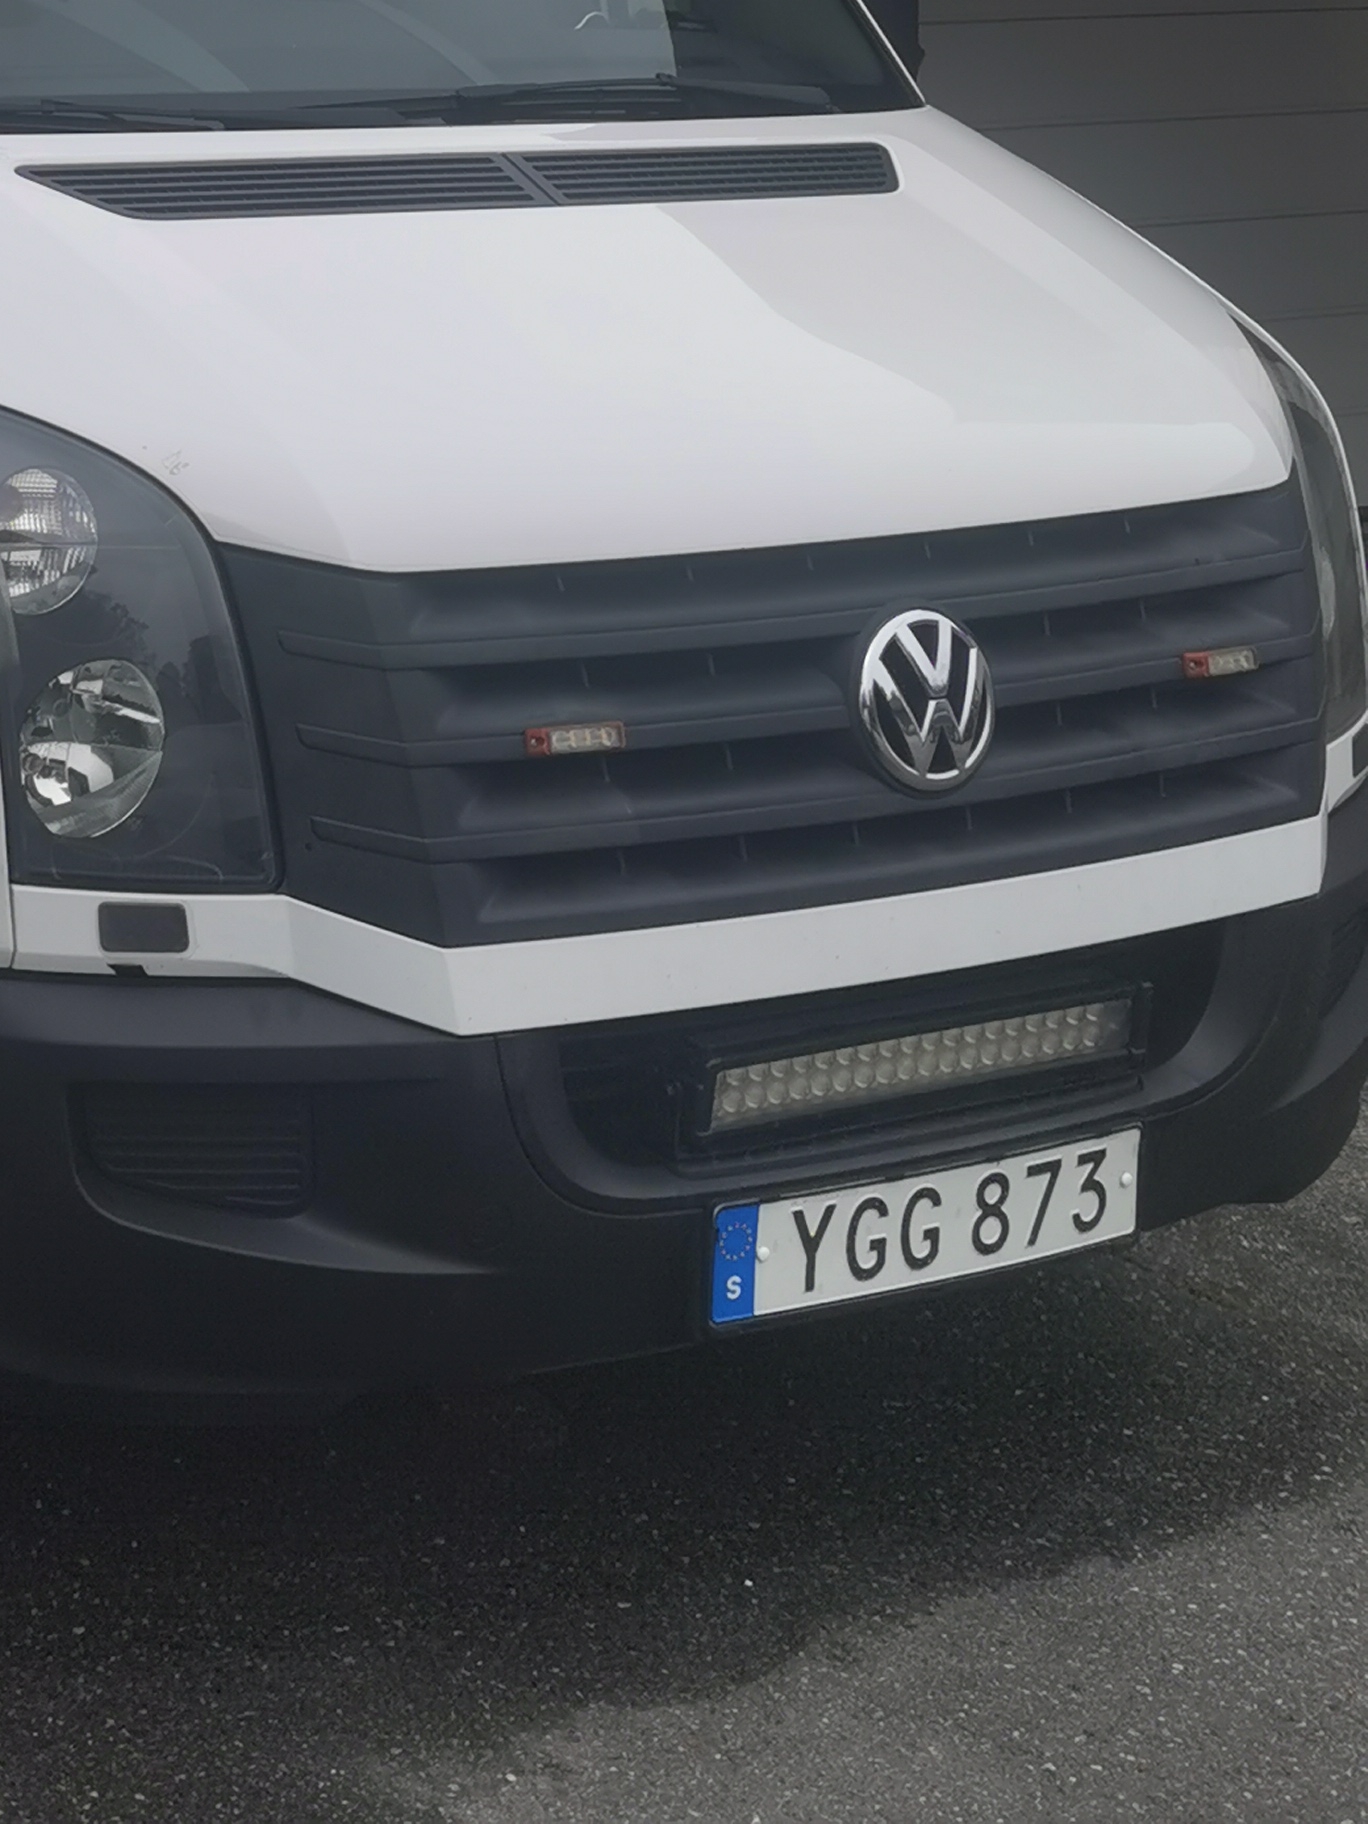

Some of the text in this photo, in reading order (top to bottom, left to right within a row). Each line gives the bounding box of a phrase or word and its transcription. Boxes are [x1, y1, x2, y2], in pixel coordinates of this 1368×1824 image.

[792, 1148, 1108, 1292] YGG 873
[725, 1275, 742, 1300] S
